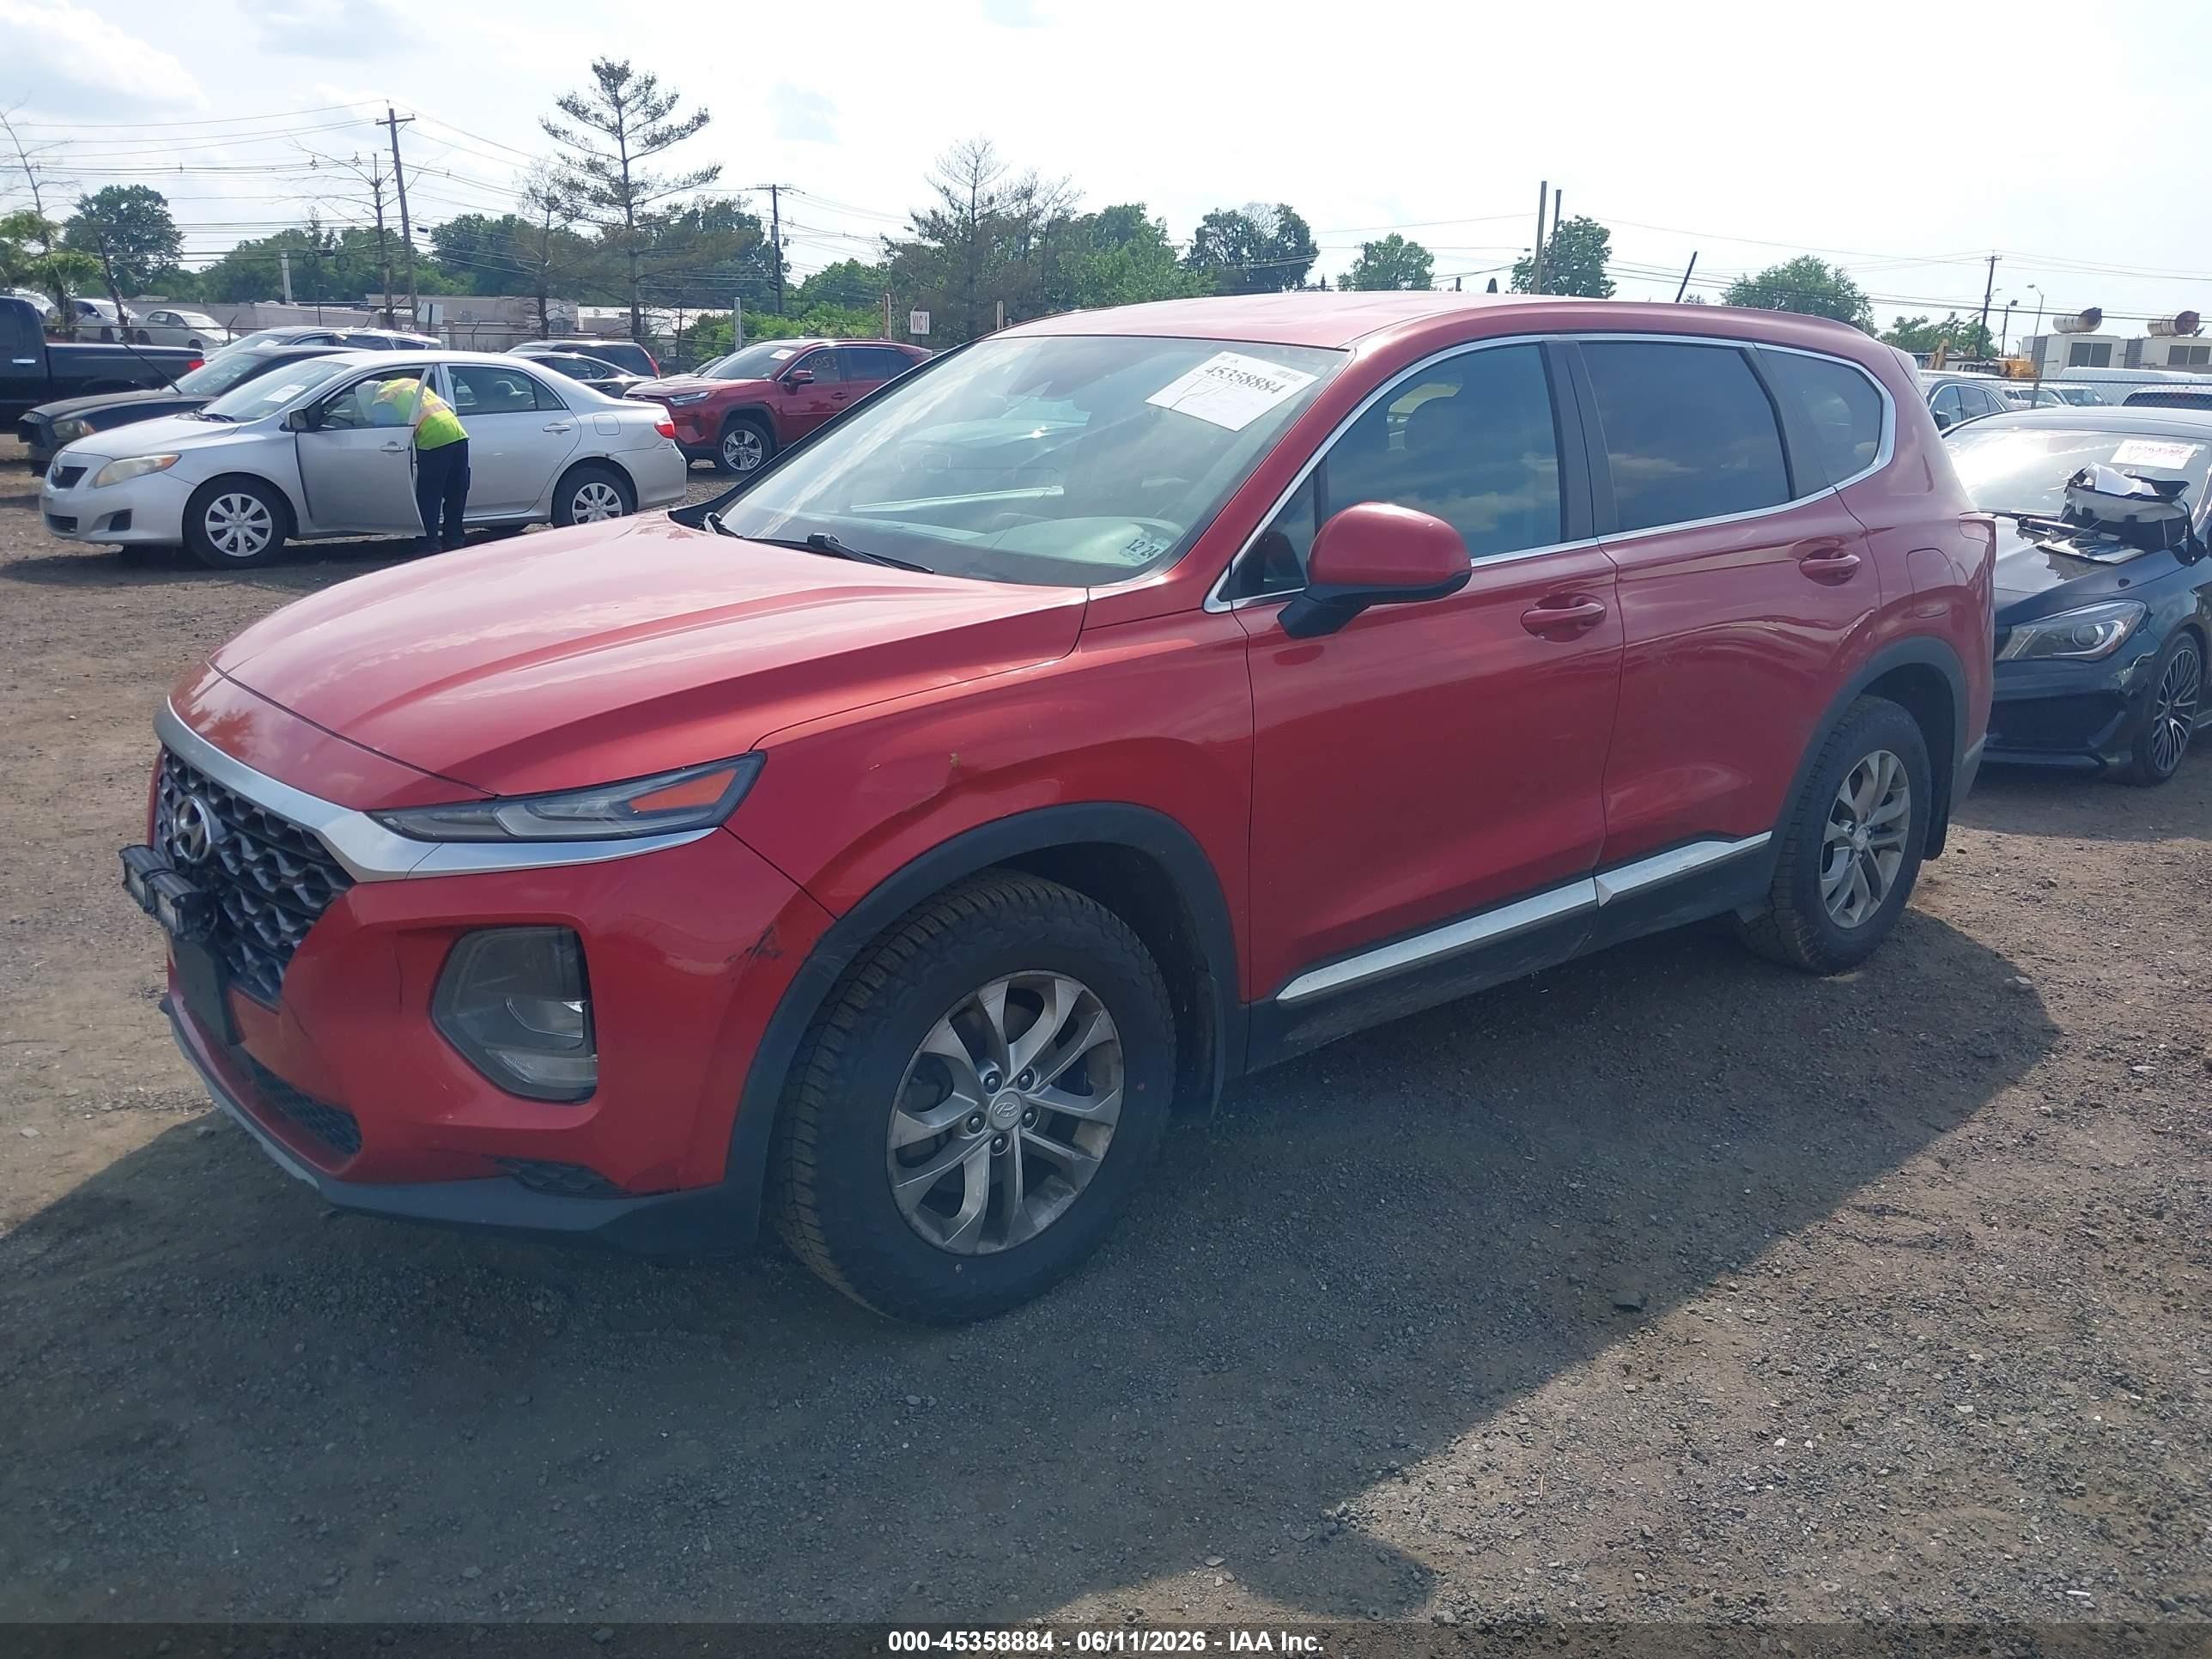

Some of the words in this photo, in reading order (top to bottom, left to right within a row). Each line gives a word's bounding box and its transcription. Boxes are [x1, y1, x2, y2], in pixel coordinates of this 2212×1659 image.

[912, 315, 923, 331] VIC
[1204, 365, 1287, 394] 45358884
[1126, 538, 1146, 552] 12
[1139, 545, 1160, 560] 24
